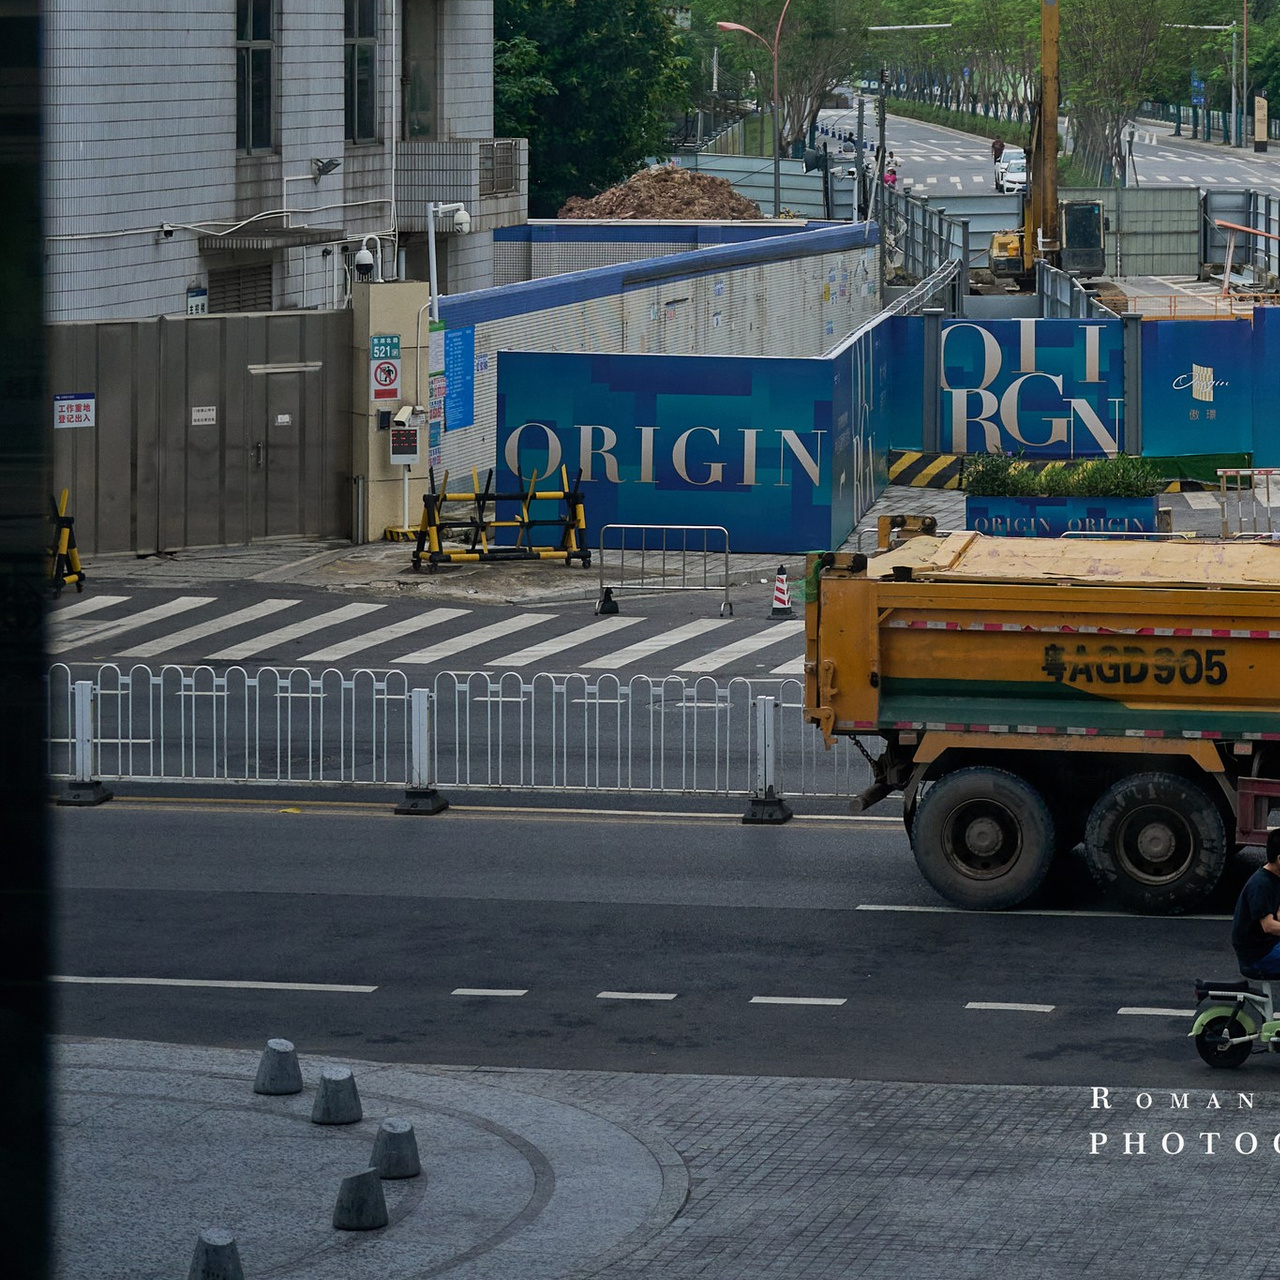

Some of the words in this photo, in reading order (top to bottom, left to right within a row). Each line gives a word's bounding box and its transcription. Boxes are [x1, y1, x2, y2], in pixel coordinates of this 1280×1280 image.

[373, 345, 390, 358] 521
[58, 403, 91, 413] 工作重地
[58, 413, 91, 424] 登记出入
[504, 422, 828, 488] ORIGIN
[974, 516, 1050, 533] ORIGIN
[1067, 517, 1145, 533] ORIGIN
